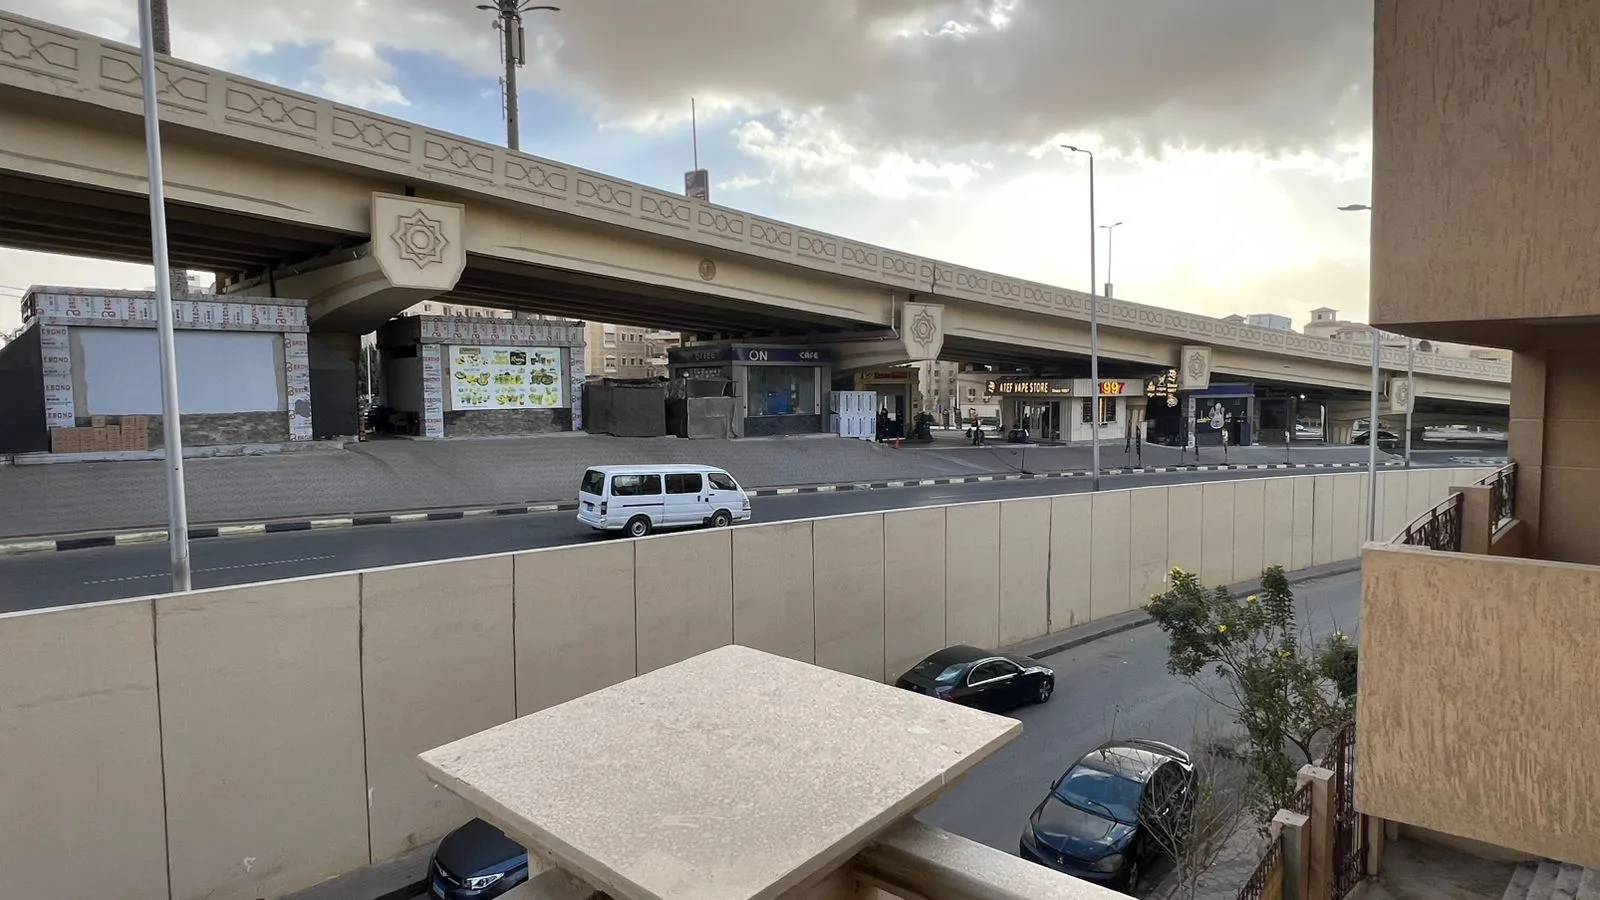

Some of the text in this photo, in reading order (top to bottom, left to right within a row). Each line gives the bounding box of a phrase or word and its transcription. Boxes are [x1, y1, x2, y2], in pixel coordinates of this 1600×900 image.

[749, 350, 768, 361] ON
[1000, 383, 1013, 393] ATEF
[1014, 383, 1029, 393] VAPE
[1029, 382, 1048, 393] STORE
[1098, 382, 1125, 394] 1997
